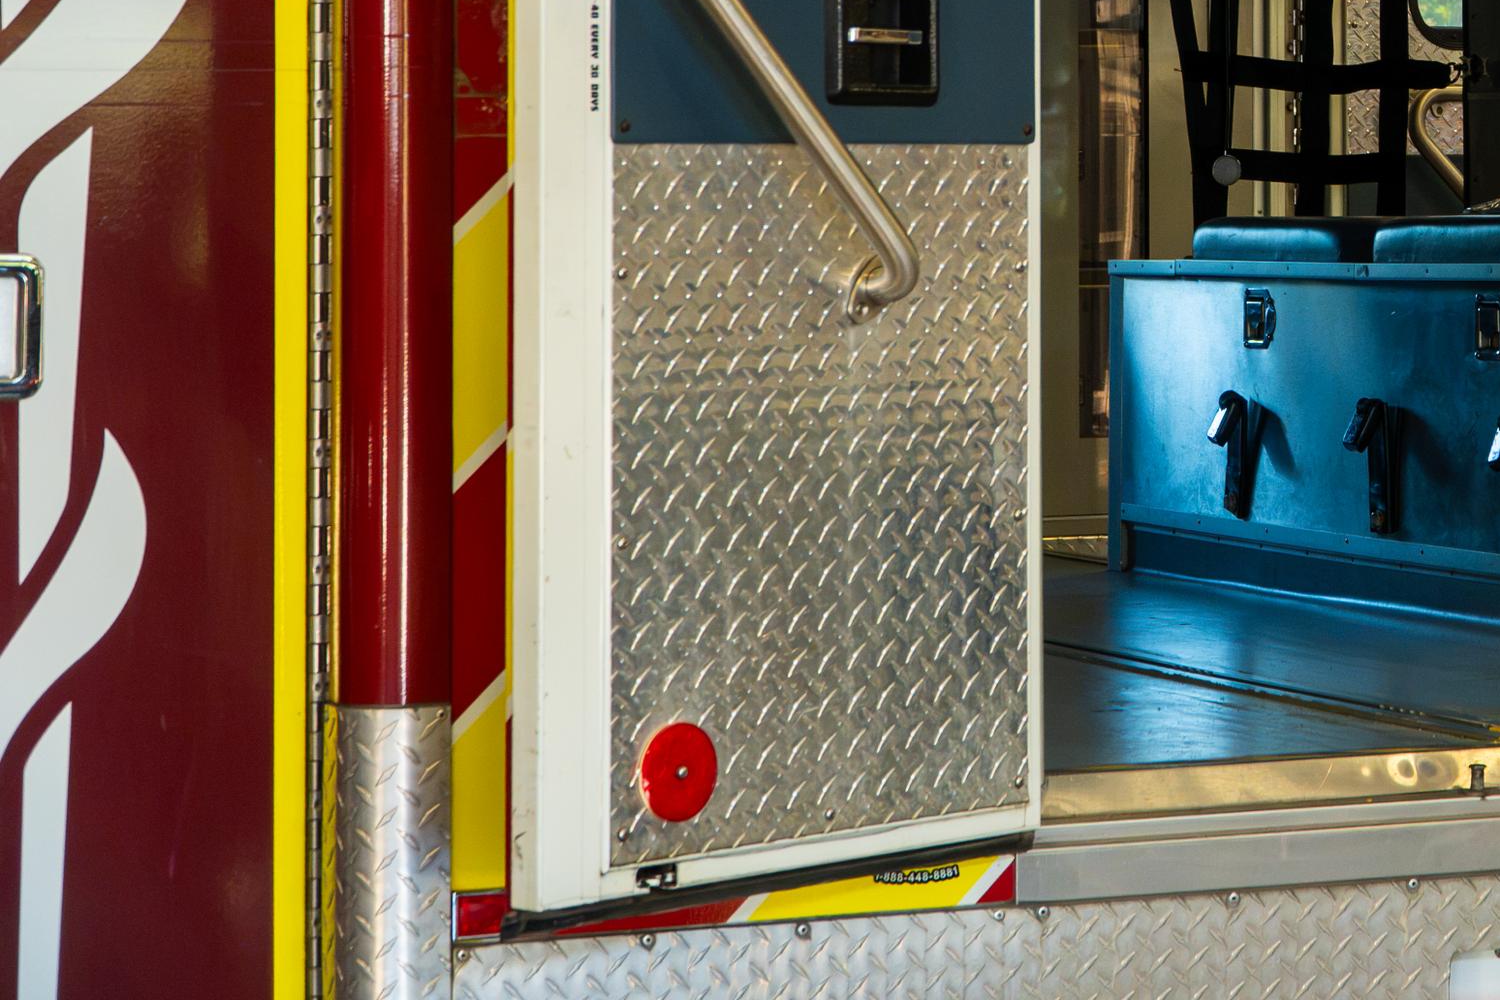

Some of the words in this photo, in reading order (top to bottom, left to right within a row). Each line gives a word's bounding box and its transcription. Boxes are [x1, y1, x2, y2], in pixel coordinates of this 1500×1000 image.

[591, 24, 599, 59] EVERY
[591, 64, 599, 79] 30
[591, 84, 599, 112] DAYS
